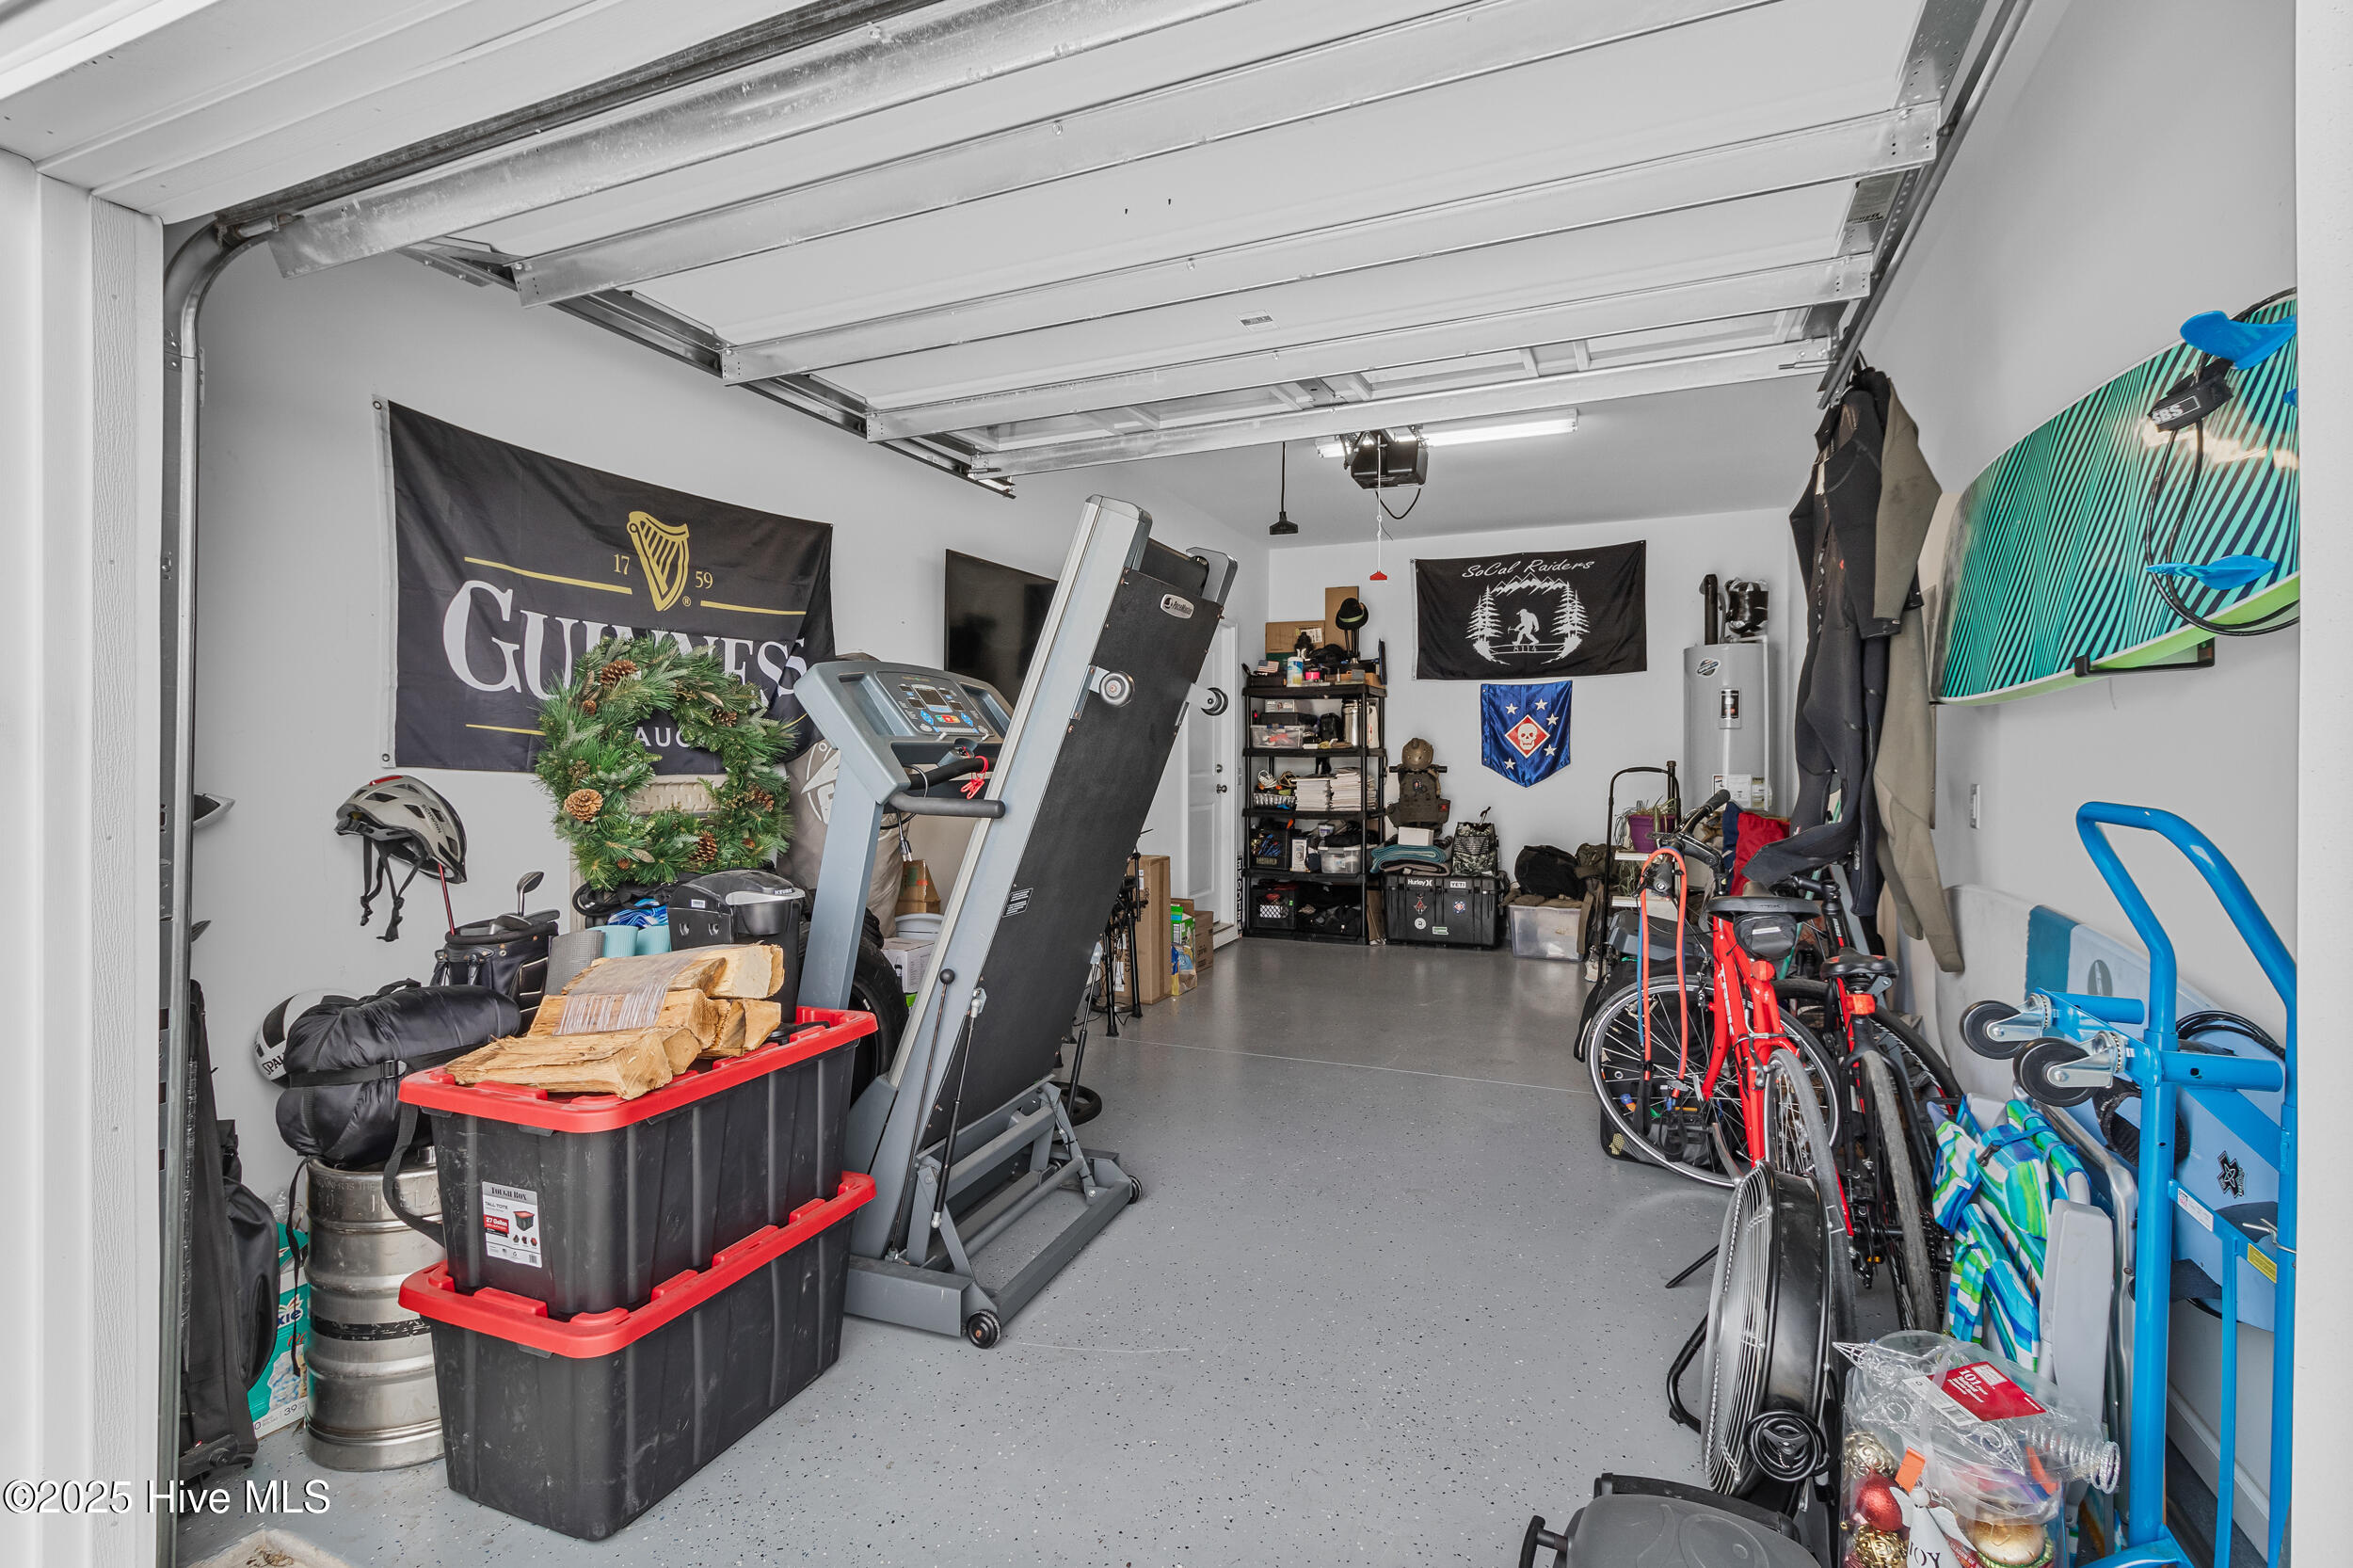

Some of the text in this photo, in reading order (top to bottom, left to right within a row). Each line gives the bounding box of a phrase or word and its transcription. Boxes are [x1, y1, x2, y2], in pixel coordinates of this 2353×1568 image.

[2153, 404, 2184, 425] SBS
[614, 553, 713, 589] 17 59
[1462, 559, 1594, 577] SoCal Raiders
[1513, 645, 1537, 653] 8114
[421, 804, 441, 834] SCHWINN
[263, 1052, 284, 1075] SPAL
[284, 1403, 297, 1416] 39
